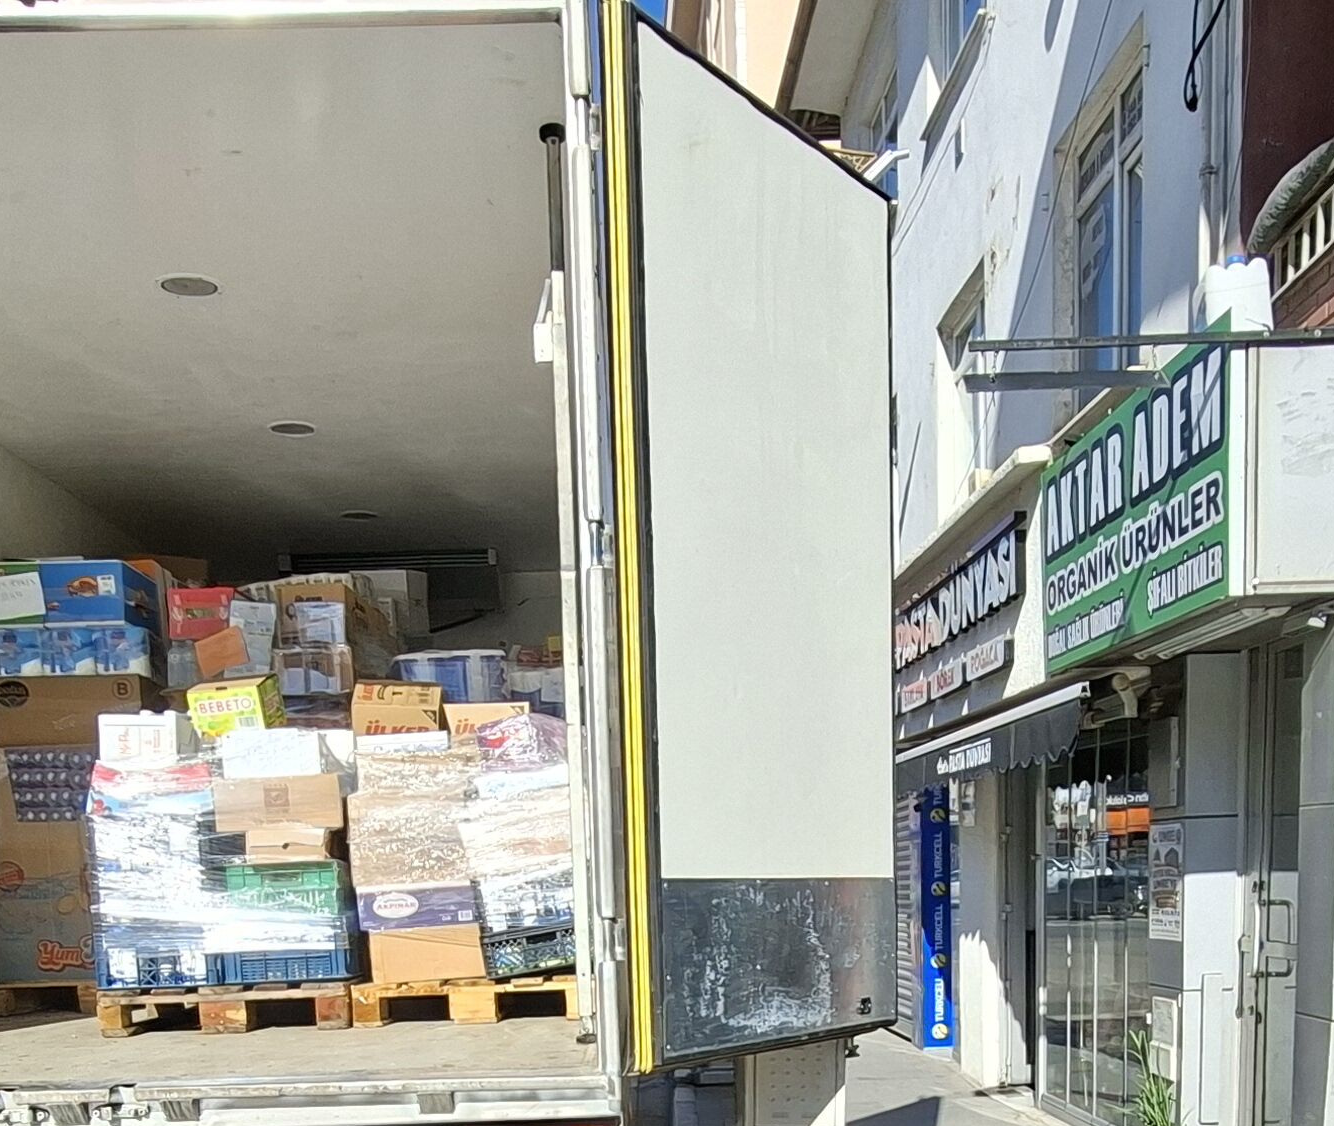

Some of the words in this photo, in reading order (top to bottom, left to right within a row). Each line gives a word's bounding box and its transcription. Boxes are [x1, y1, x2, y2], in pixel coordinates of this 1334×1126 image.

[1047, 432, 1123, 557] AKTAR
[1132, 346, 1222, 499] ADEM
[1047, 540, 1117, 612] ORGANİK
[1122, 478, 1222, 568] ÜRÜNLER
[1147, 571, 1177, 615] ŞİFALI
[1178, 545, 1223, 597] BİTKİLER
[198, 698, 252, 715] BEBETO
[934, 903, 943, 951] TURKCELL
